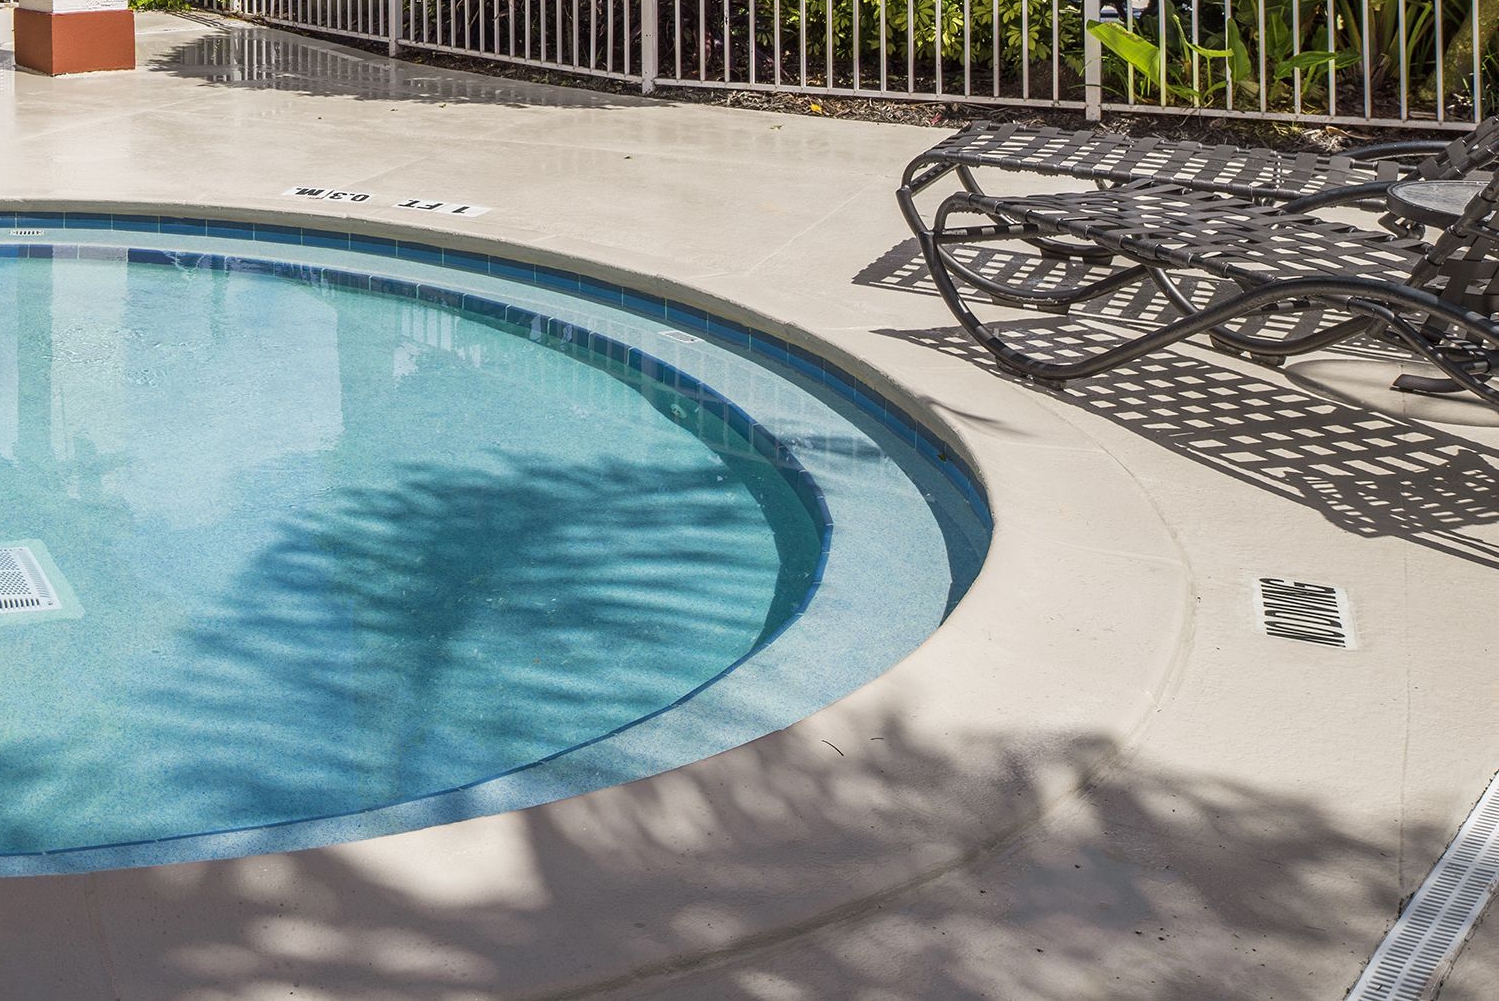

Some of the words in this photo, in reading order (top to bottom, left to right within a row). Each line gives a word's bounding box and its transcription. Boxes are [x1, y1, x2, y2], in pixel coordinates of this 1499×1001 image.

[329, 192, 370, 202] 0.3
[452, 206, 470, 214] 1
[1258, 577, 1343, 629] DIVING
[1264, 620, 1346, 648] NO
